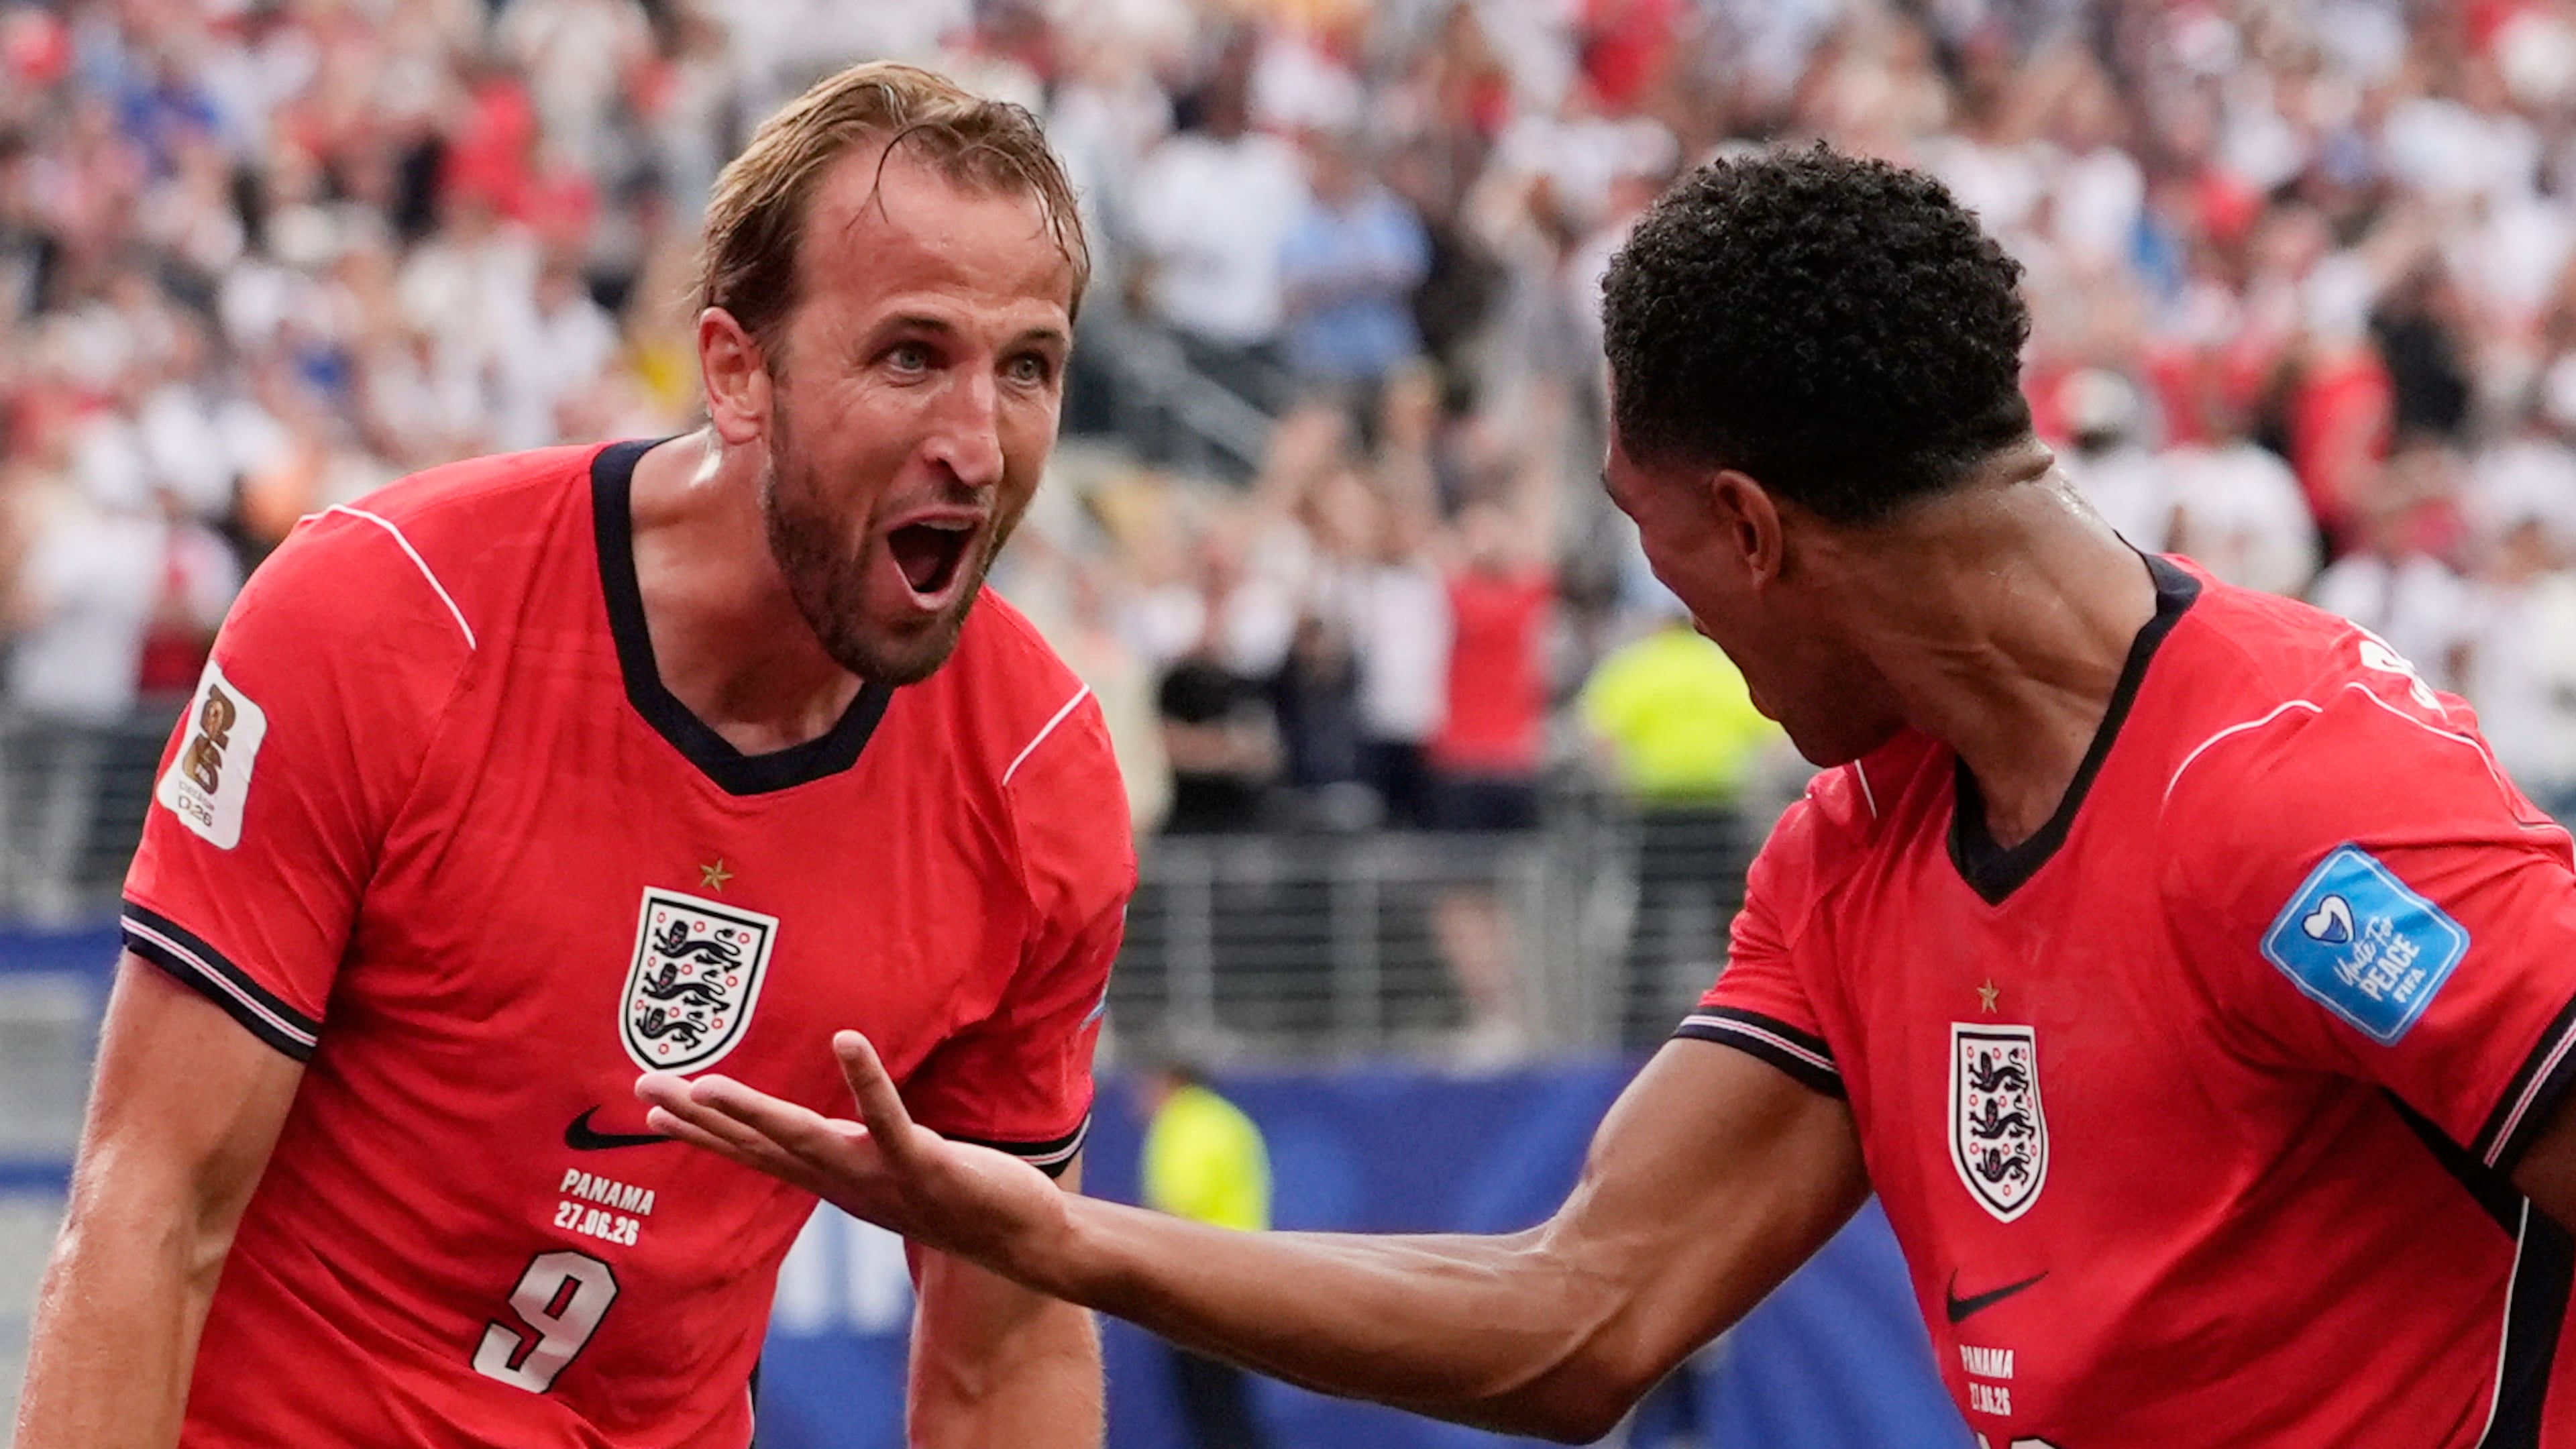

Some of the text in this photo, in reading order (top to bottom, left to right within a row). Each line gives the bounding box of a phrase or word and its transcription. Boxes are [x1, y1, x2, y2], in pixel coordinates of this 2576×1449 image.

[2333, 939, 2377, 987] Unite
[2358, 932, 2420, 1002] PEACE
[2392, 967, 2427, 1003] FIFA
[559, 1168, 655, 1216] PANAMA
[553, 1201, 640, 1246] 27.06.26
[472, 1250, 619, 1395] 9
